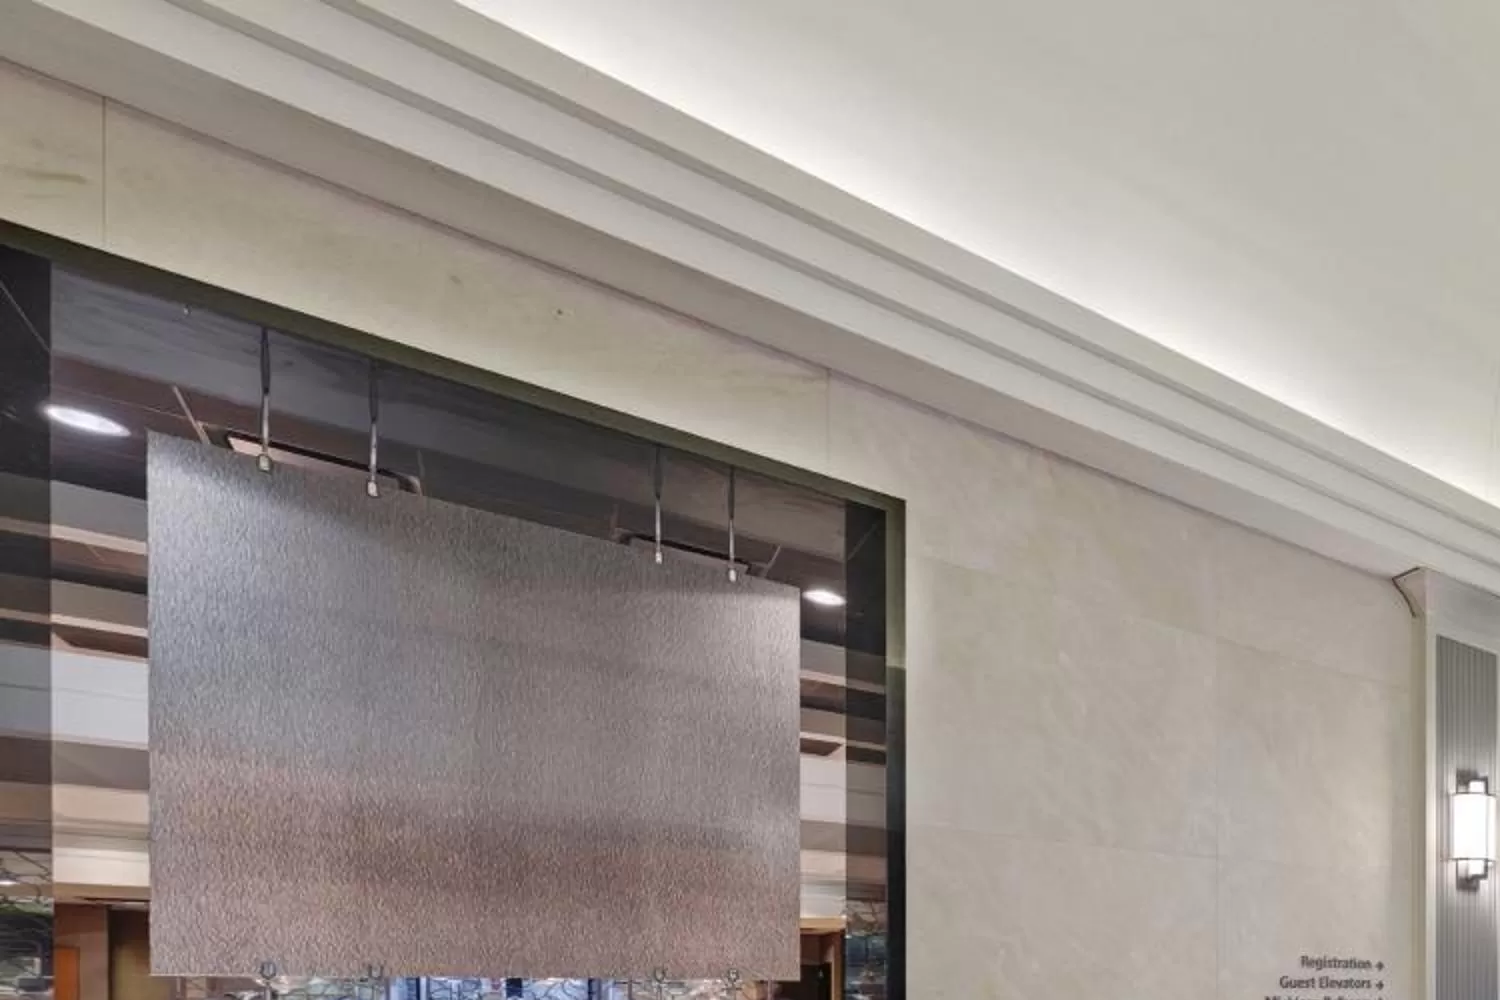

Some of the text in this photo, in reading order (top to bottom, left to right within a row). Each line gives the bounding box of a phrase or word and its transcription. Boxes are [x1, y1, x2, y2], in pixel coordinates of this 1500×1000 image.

[1300, 955, 1372, 971] Registration
[1279, 975, 1372, 989] Guest Elevators
